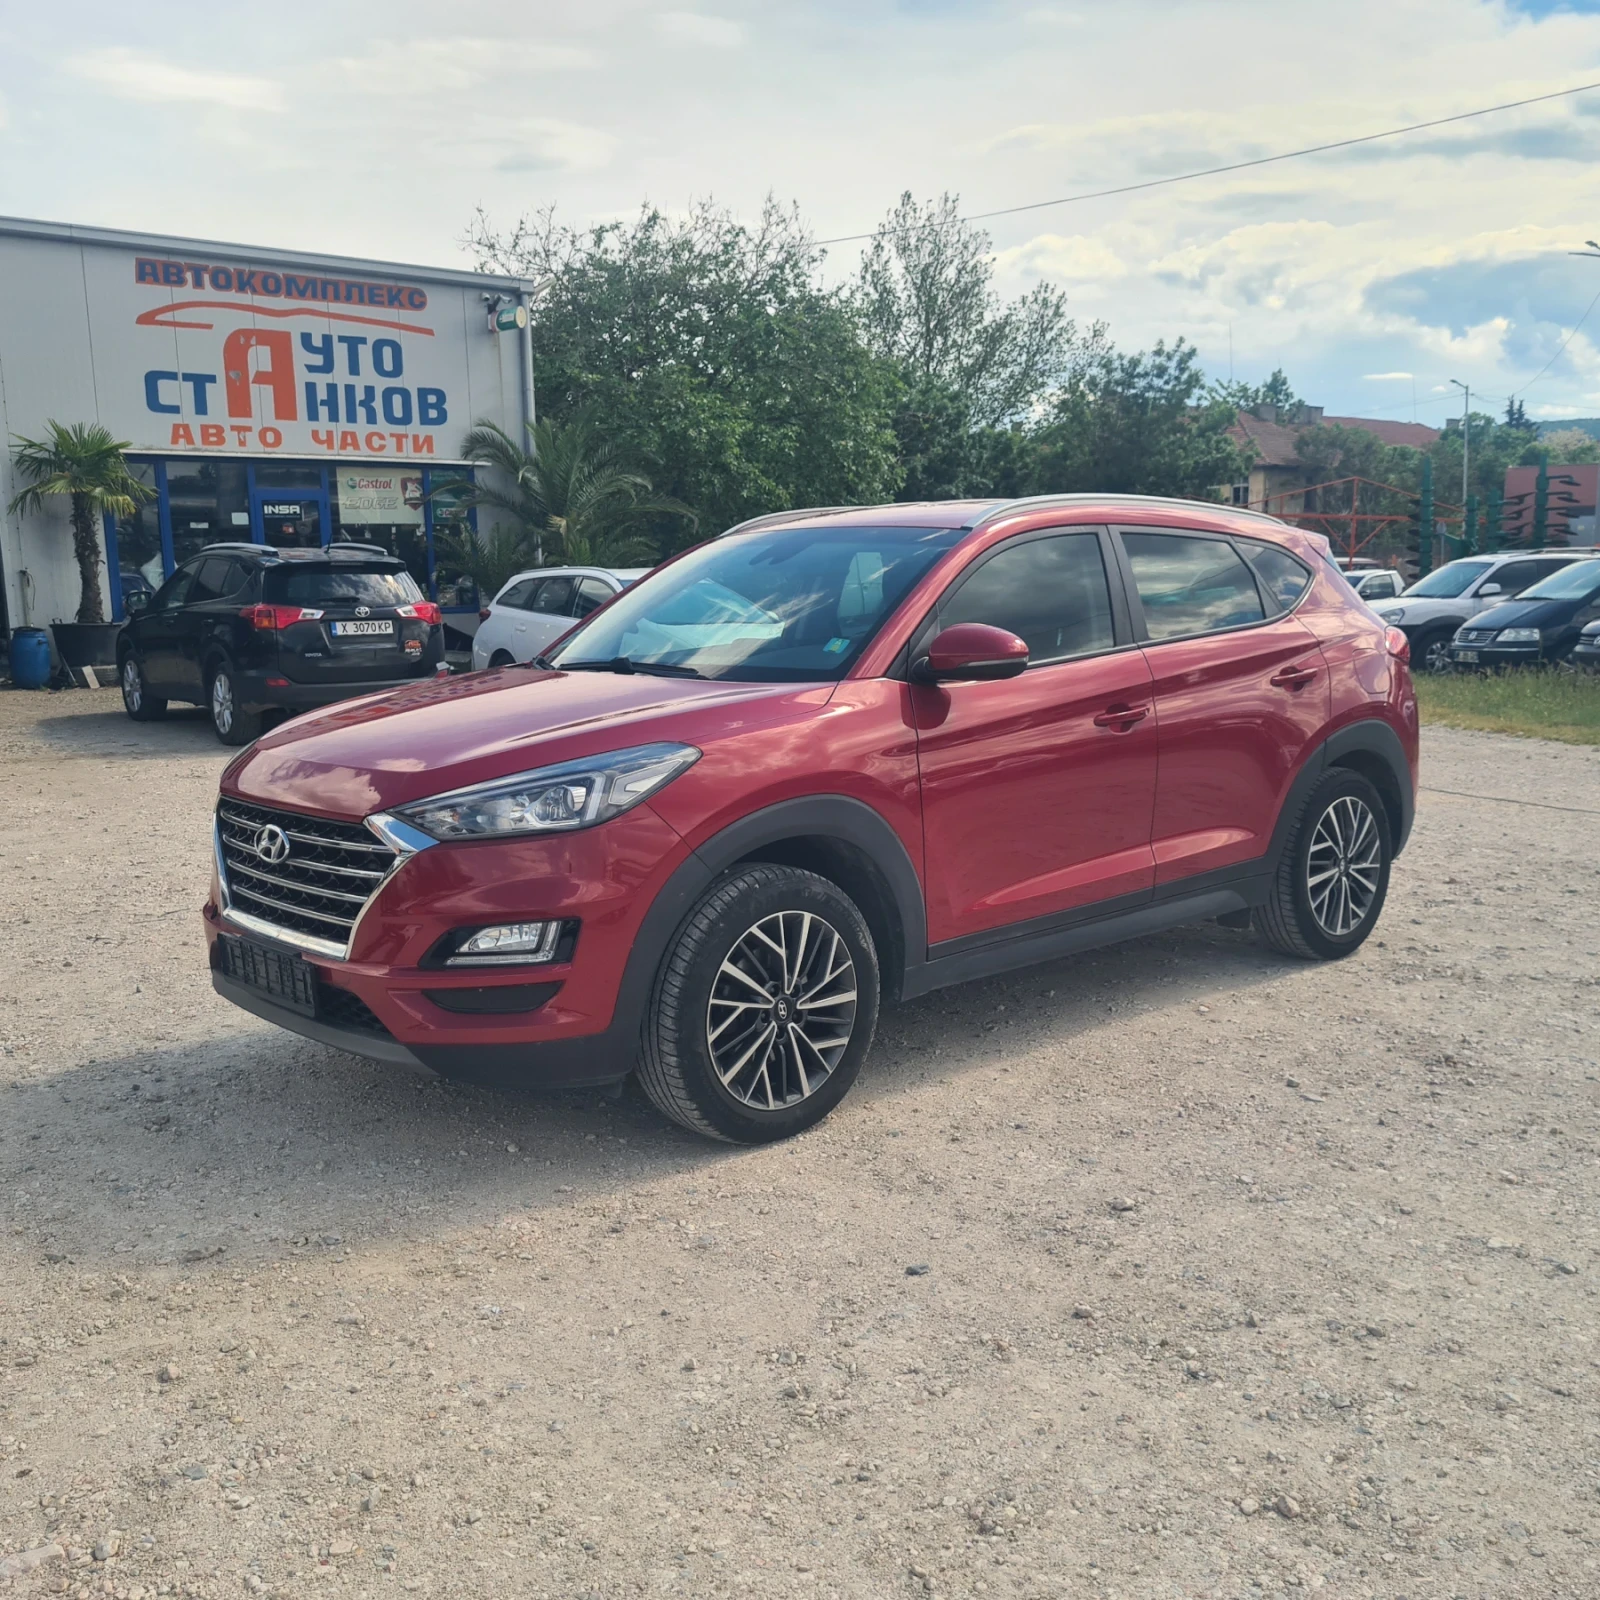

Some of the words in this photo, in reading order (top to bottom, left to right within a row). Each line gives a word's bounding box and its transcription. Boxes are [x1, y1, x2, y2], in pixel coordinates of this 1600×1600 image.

[136, 258, 427, 310] АВТОКОМПЛЕКС
[170, 423, 283, 448] АВТО
[311, 429, 435, 454] ЧАСТИ
[358, 478, 392, 490] Castrol
[263, 504, 300, 514] INSA
[343, 497, 398, 510] EDGE
[353, 622, 377, 633] 3070
